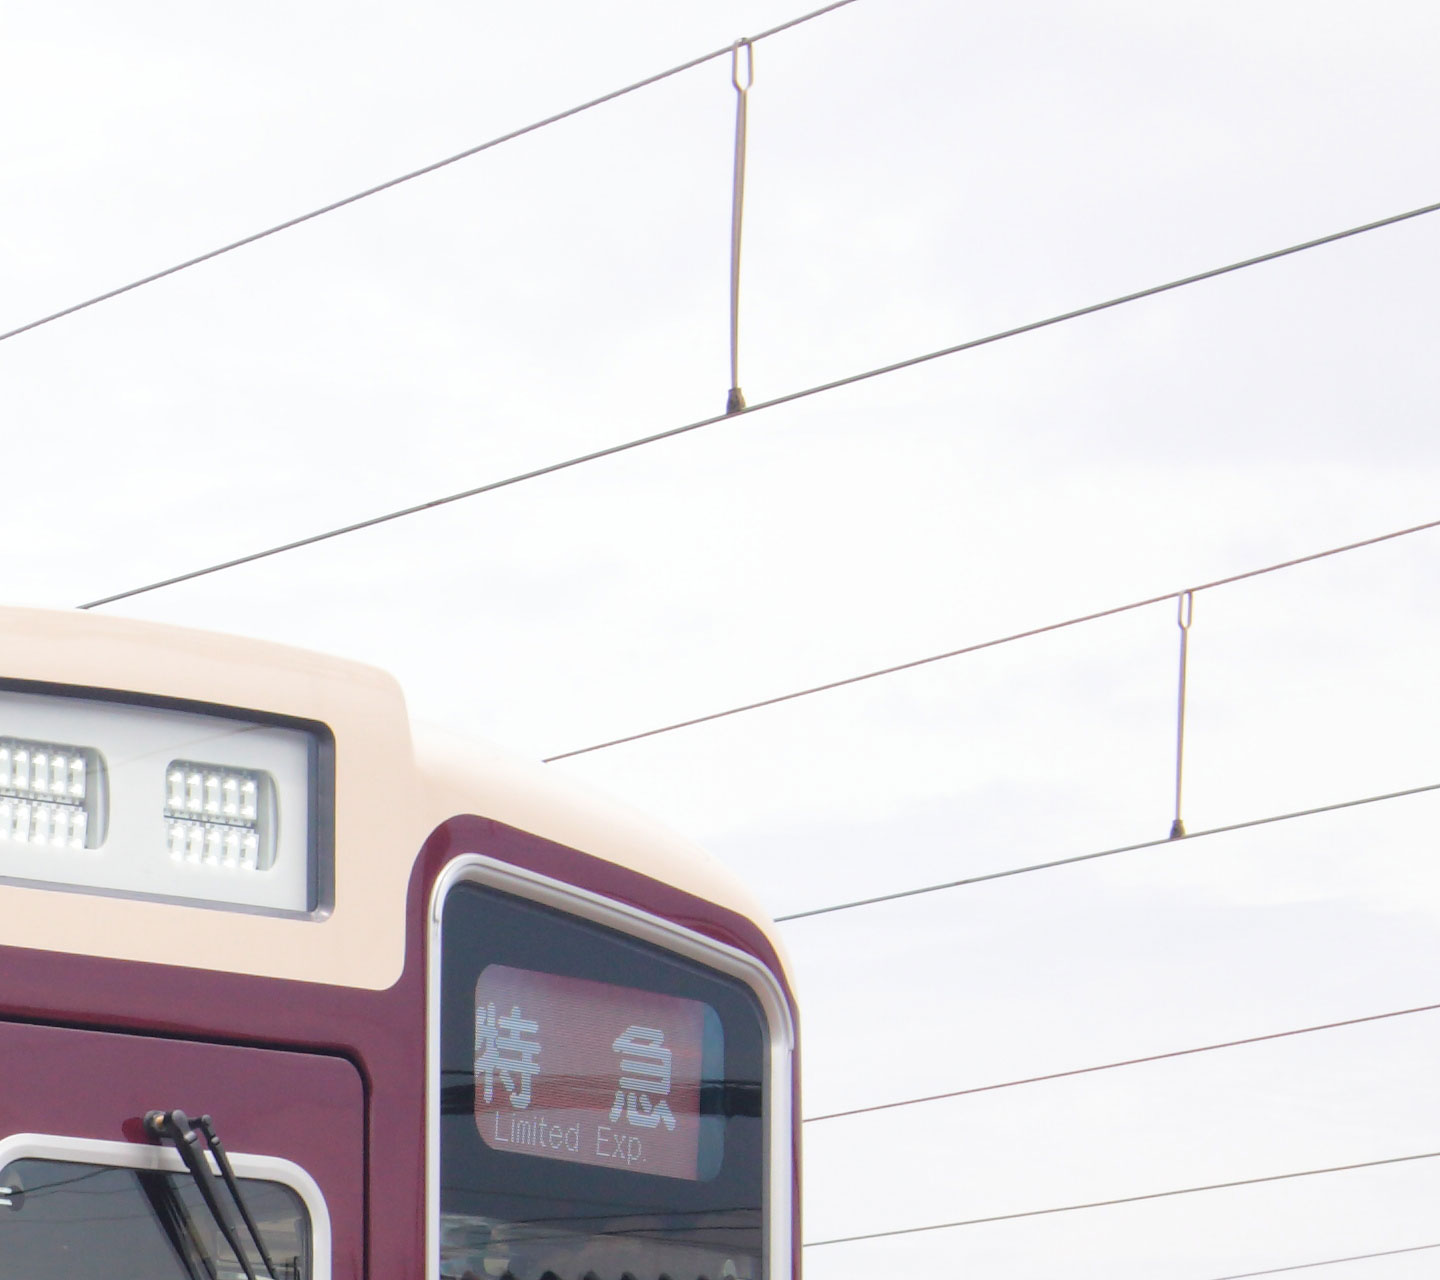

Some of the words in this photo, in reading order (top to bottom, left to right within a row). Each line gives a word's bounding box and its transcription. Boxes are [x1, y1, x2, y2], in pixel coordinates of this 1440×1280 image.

[474, 1002, 677, 1132] 特急
[493, 1113, 580, 1153] Limited
[595, 1126, 648, 1165] Exp.
